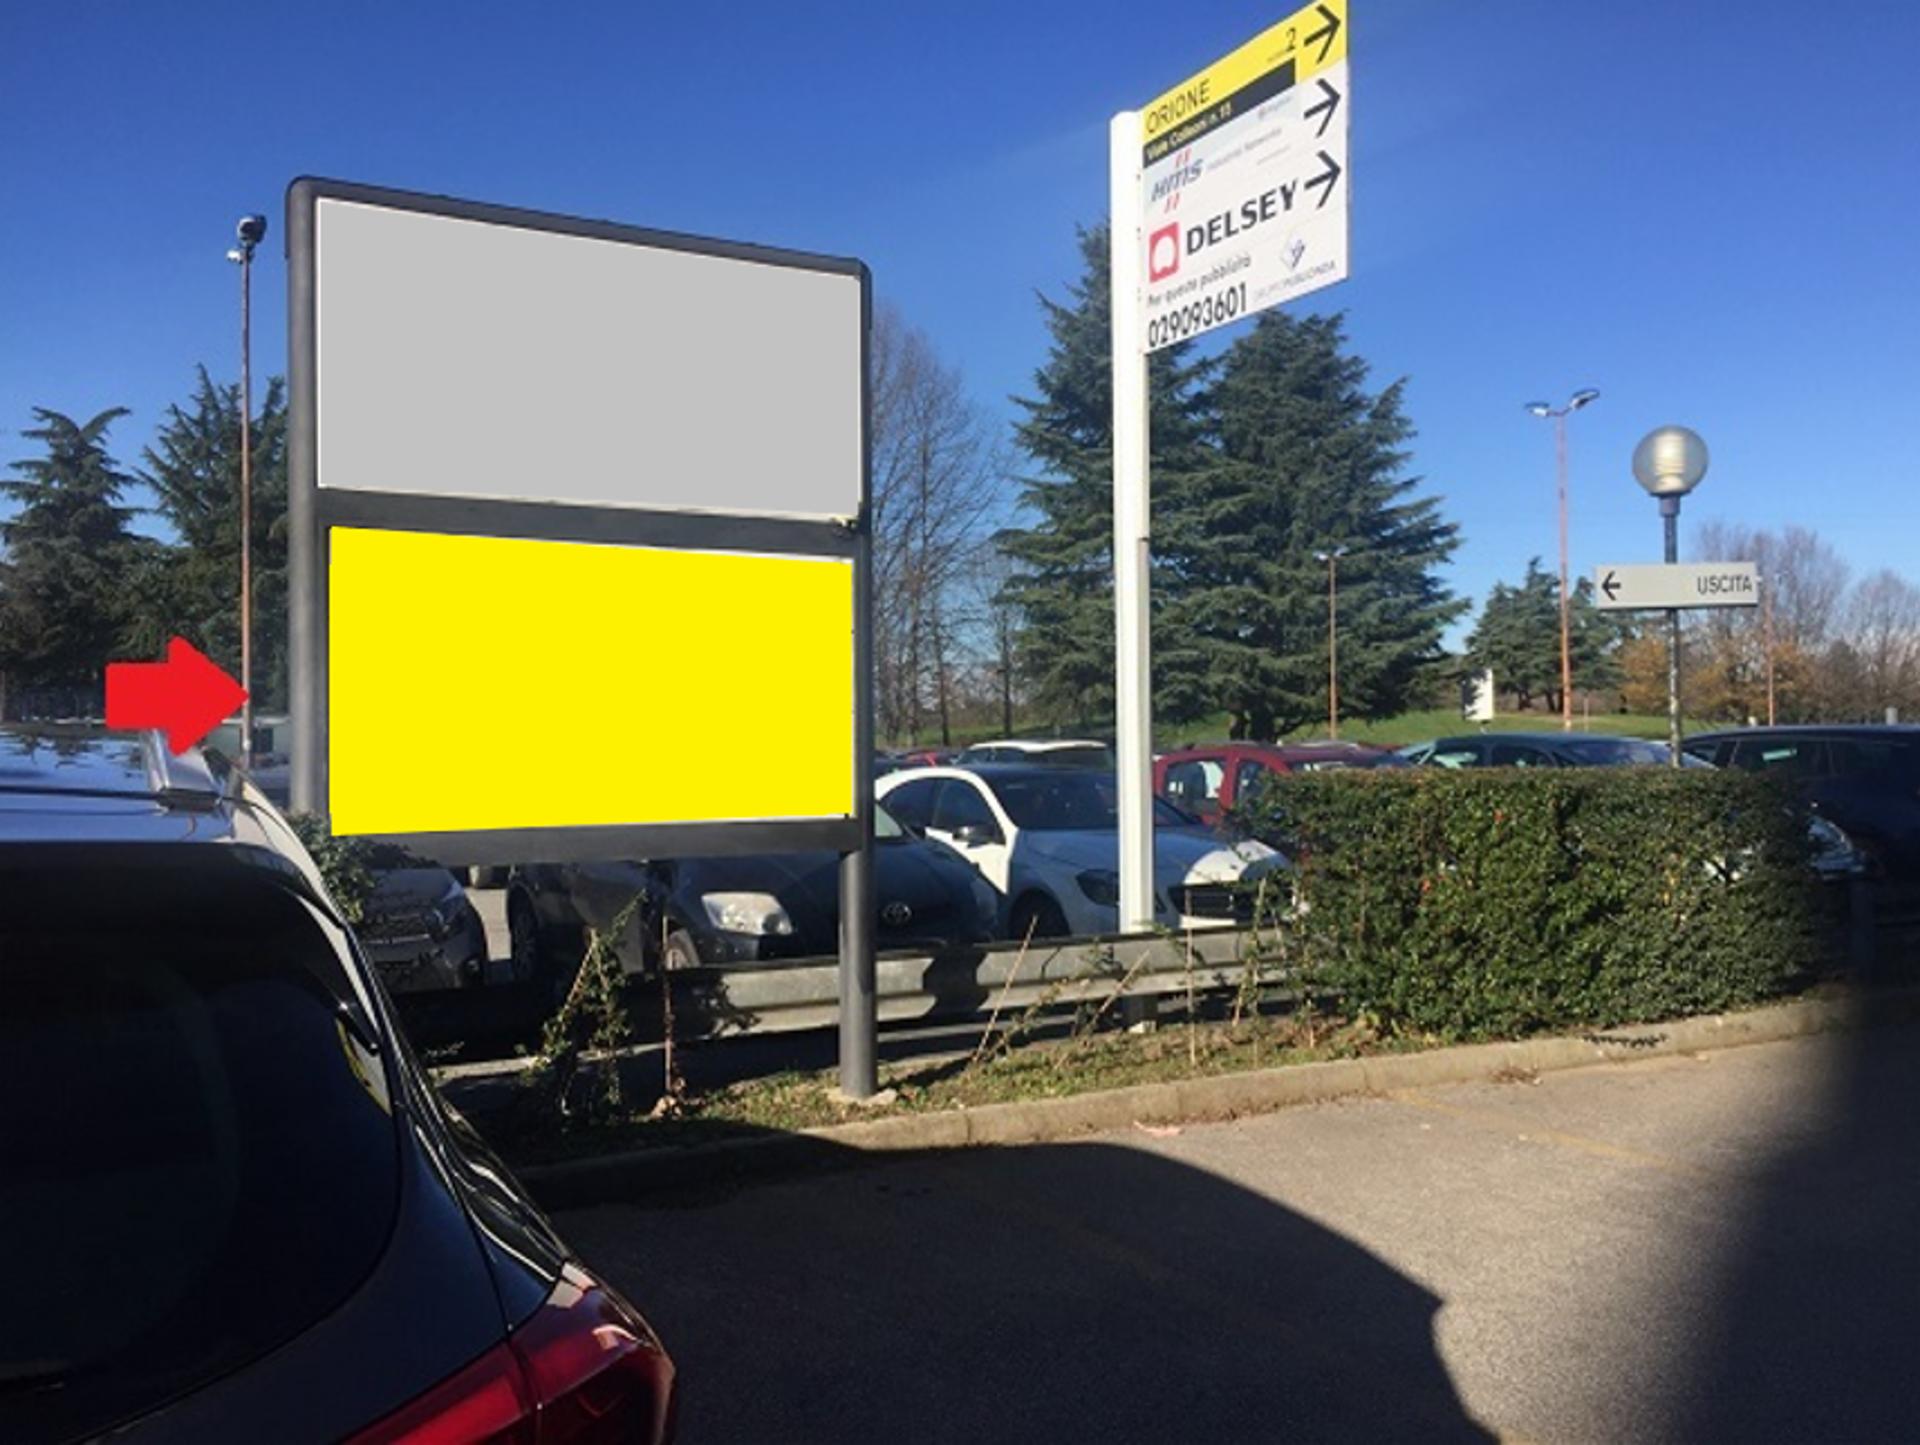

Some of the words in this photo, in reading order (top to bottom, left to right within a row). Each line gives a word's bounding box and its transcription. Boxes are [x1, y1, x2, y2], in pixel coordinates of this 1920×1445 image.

[1146, 79, 1211, 133] ORIONE
[1186, 178, 1299, 256] DELSEY
[1149, 282, 1246, 348] 029093601
[1697, 574, 1753, 595] USCITA
